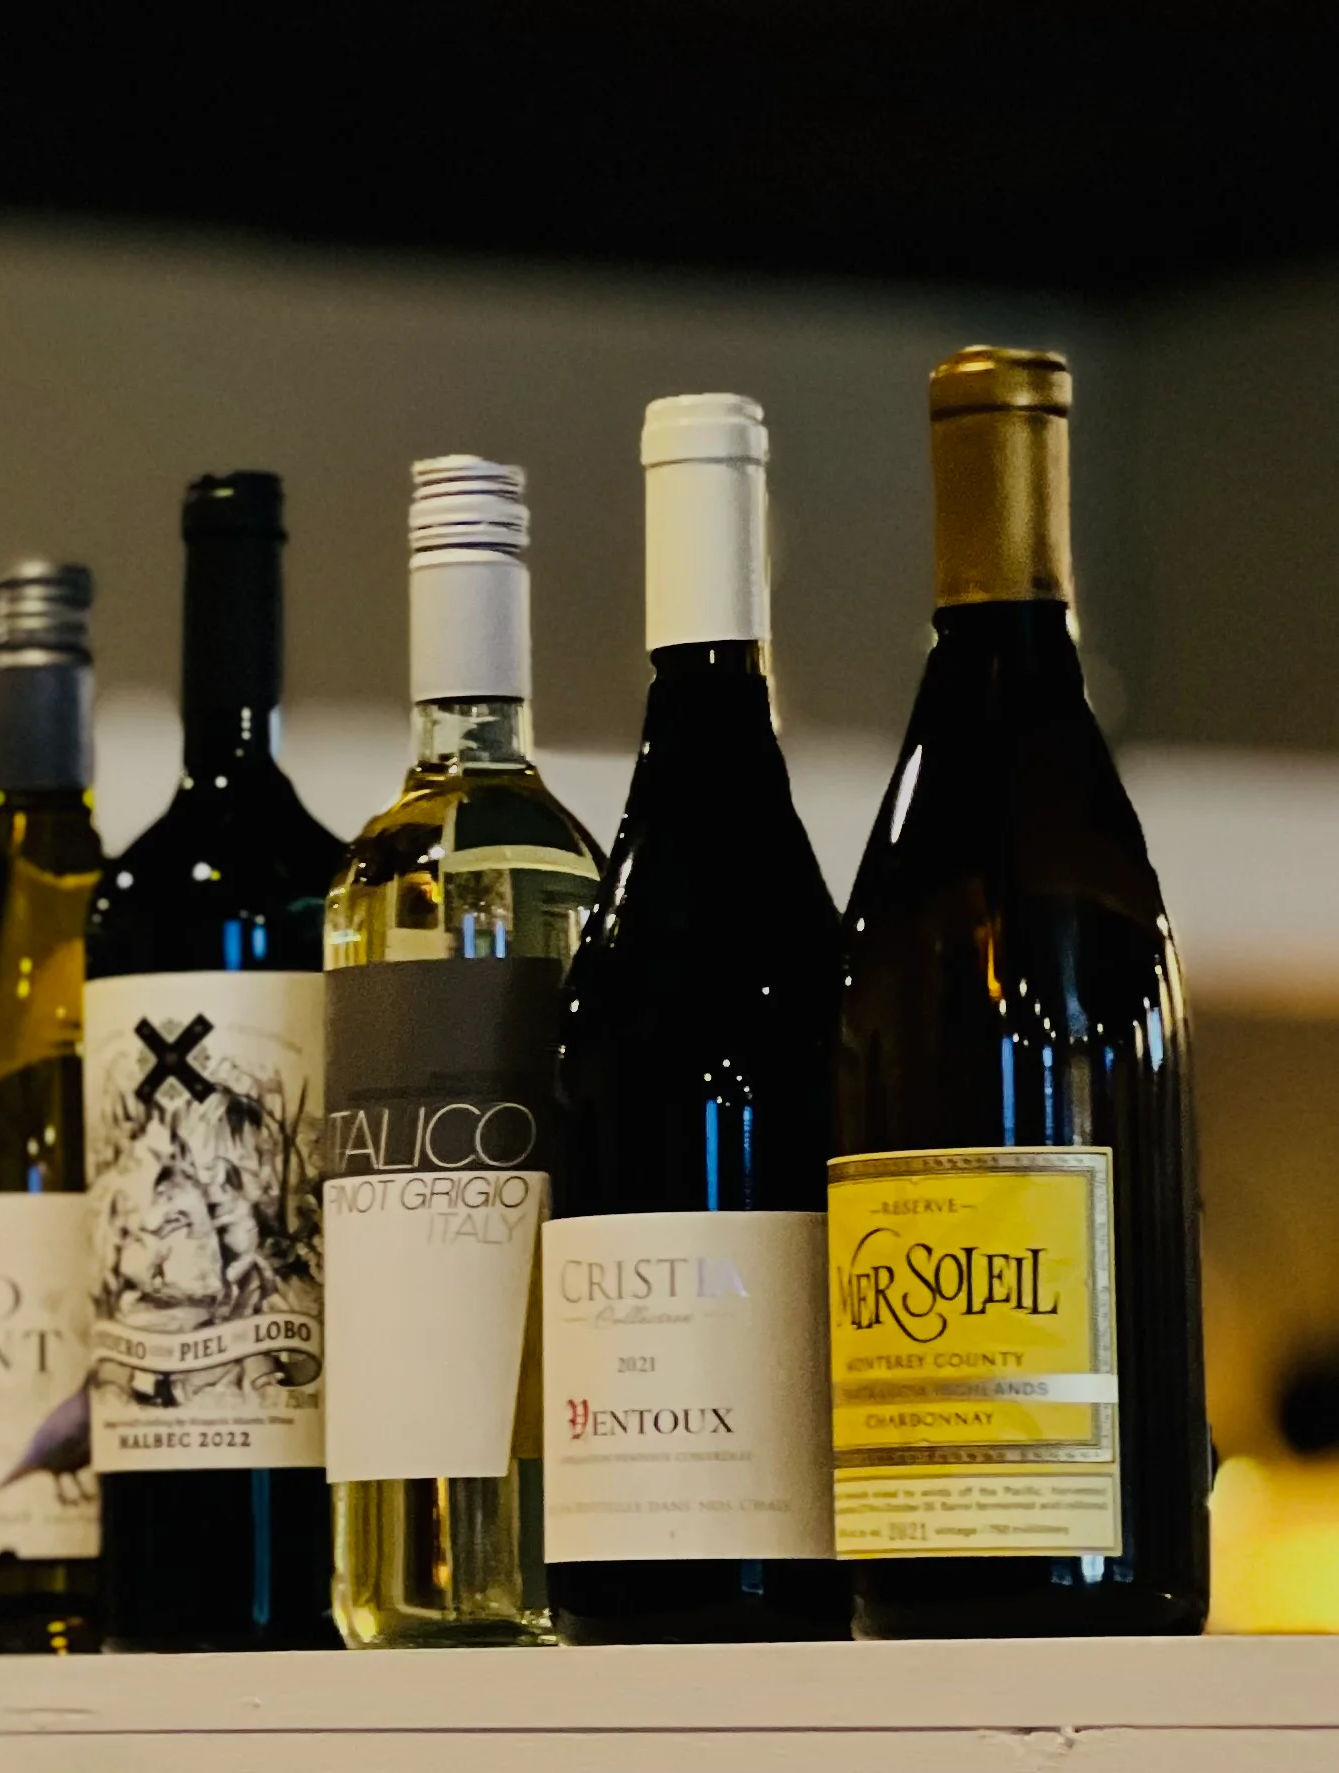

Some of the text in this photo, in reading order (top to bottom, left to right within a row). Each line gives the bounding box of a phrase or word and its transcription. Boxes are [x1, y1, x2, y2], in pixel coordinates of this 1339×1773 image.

[400, 1176, 529, 1210] GRIGIO
[882, 1199, 958, 1215] RESERVE
[428, 1211, 527, 1245] ITALY
[902, 1243, 1061, 1317] SOLEIL
[180, 1335, 228, 1361] PIEL
[254, 1320, 311, 1344] LOBO
[617, 1357, 656, 1373] 2021
[933, 1351, 1025, 1368] COUNTY
[865, 1412, 994, 1429] CHARDONNAY
[119, 1431, 251, 1450] MALBEC 2022
